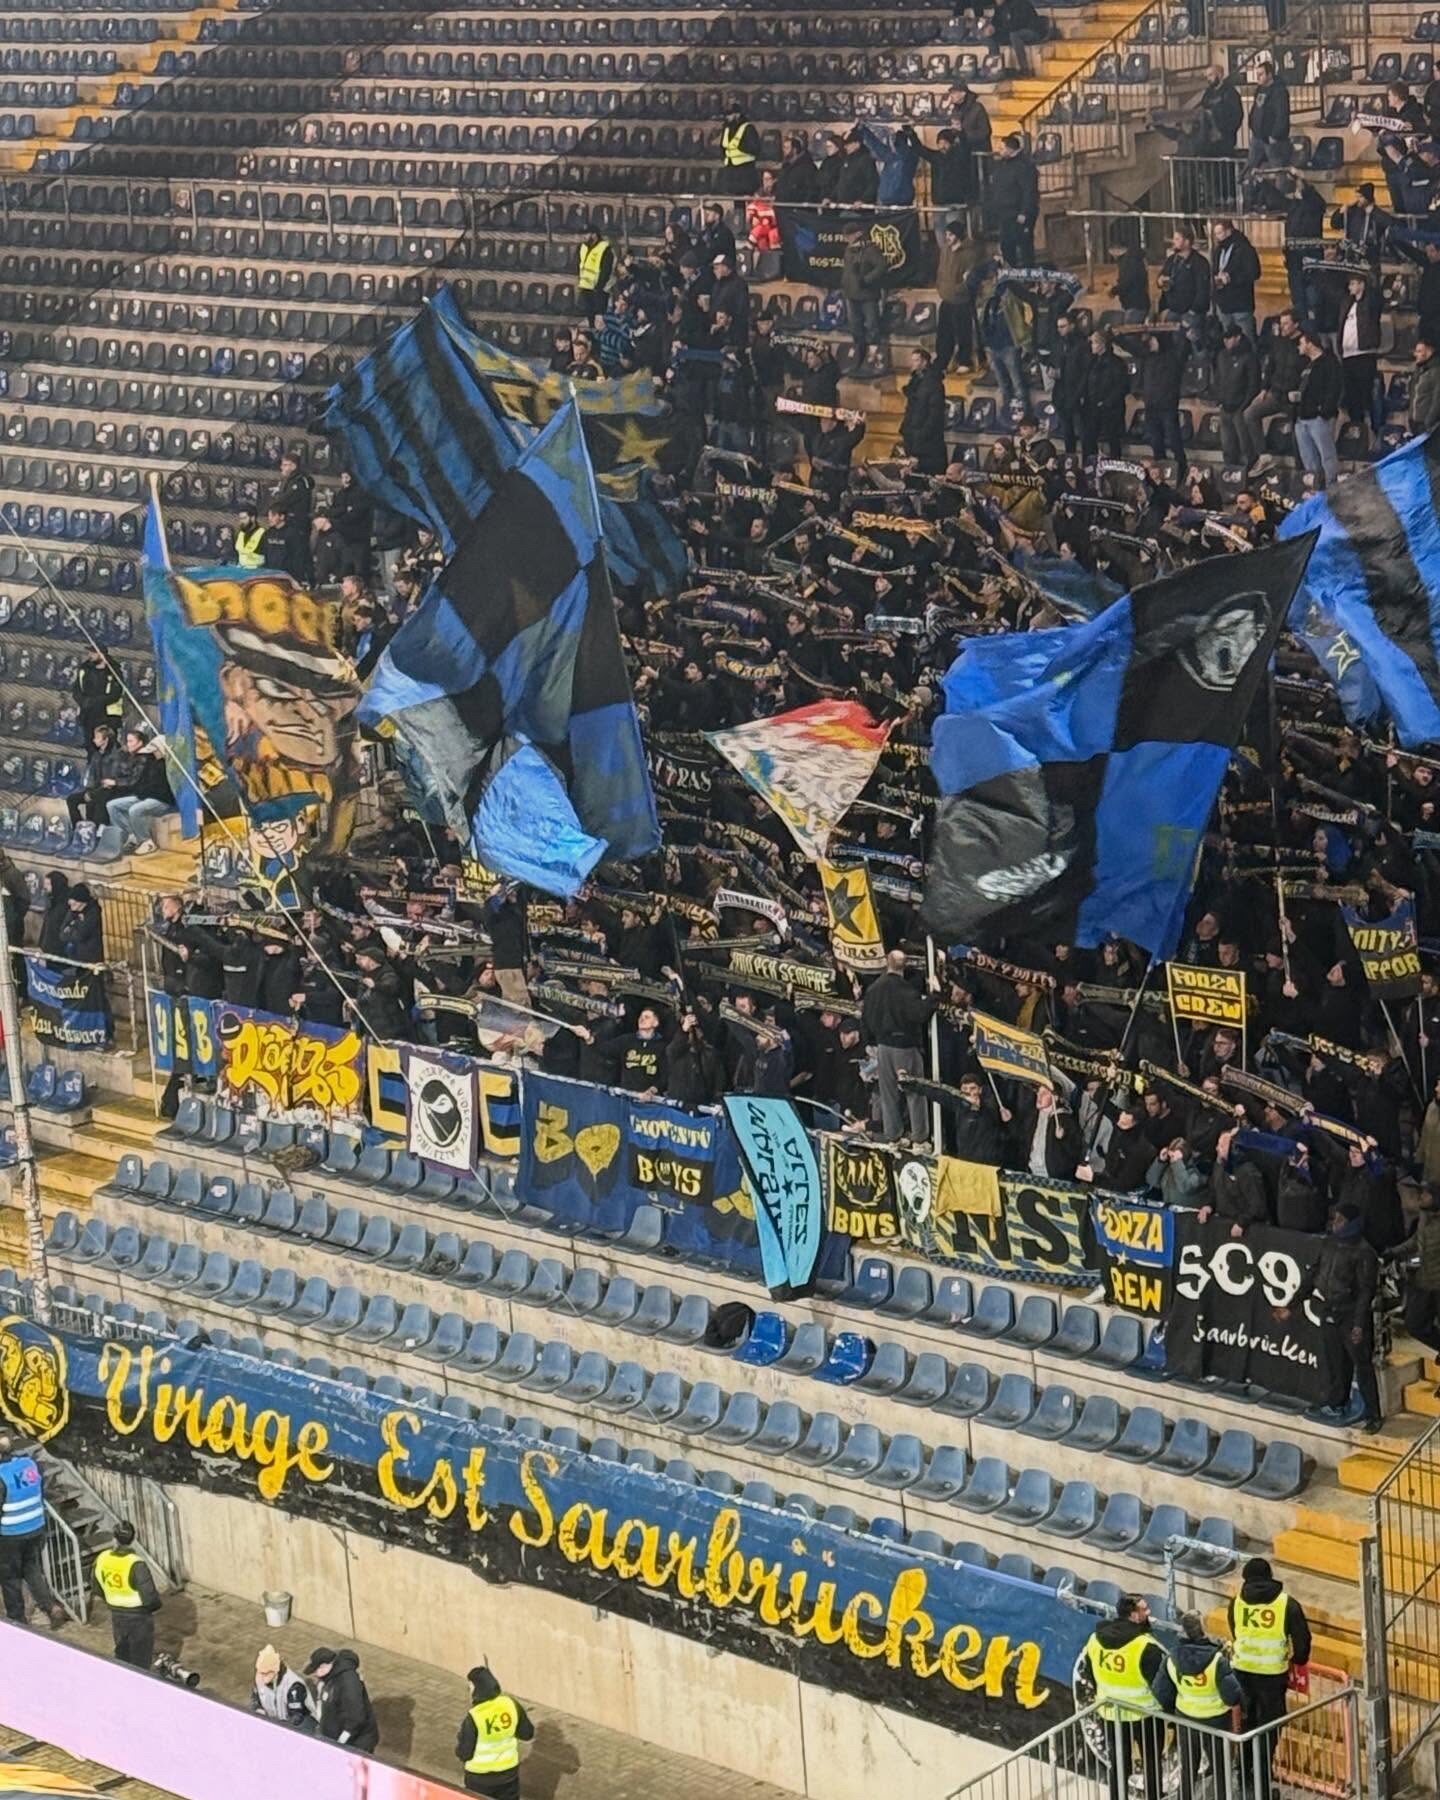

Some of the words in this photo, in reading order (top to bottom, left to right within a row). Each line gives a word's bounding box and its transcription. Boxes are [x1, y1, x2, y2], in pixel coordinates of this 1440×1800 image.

[834, 1206, 897, 1238] BOYS
[1110, 1267, 1162, 1312] REW
[13, 1466, 37, 1489] K9
[99, 1342, 335, 1499] Virage
[378, 1411, 491, 1532] Est
[509, 1450, 1050, 1709] Saarbrücken
[101, 1569, 123, 1588] K9
[1242, 1607, 1276, 1629] K9
[1098, 1649, 1126, 1673] K9
[484, 1711, 512, 1736] K9
